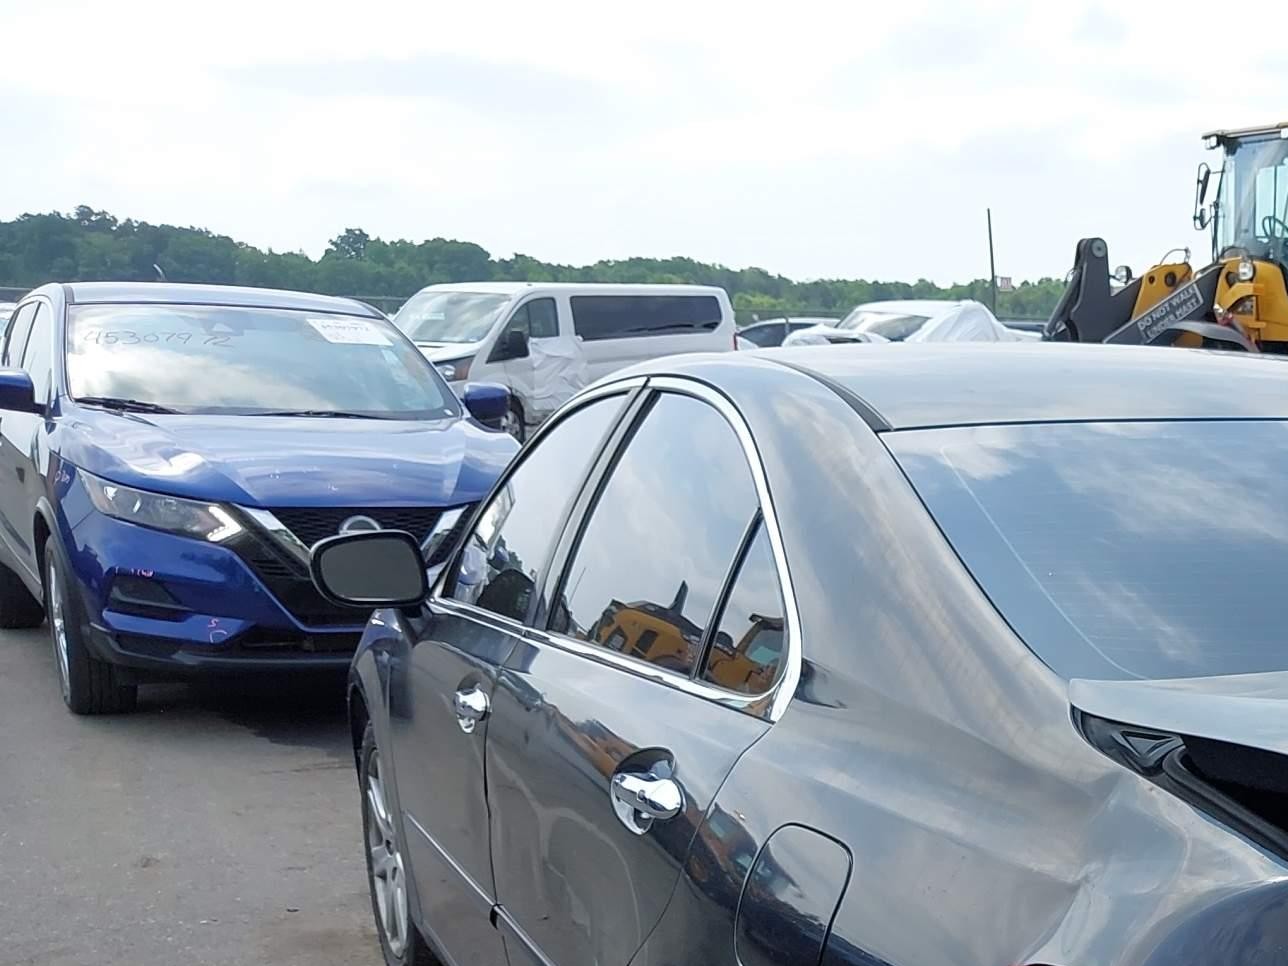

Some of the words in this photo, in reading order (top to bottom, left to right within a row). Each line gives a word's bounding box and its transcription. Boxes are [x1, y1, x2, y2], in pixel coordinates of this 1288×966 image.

[1137, 315, 1153, 330] DO
[1151, 302, 1171, 321] NOT
[1169, 284, 1196, 306] WALK
[1175, 297, 1198, 320] MAST
